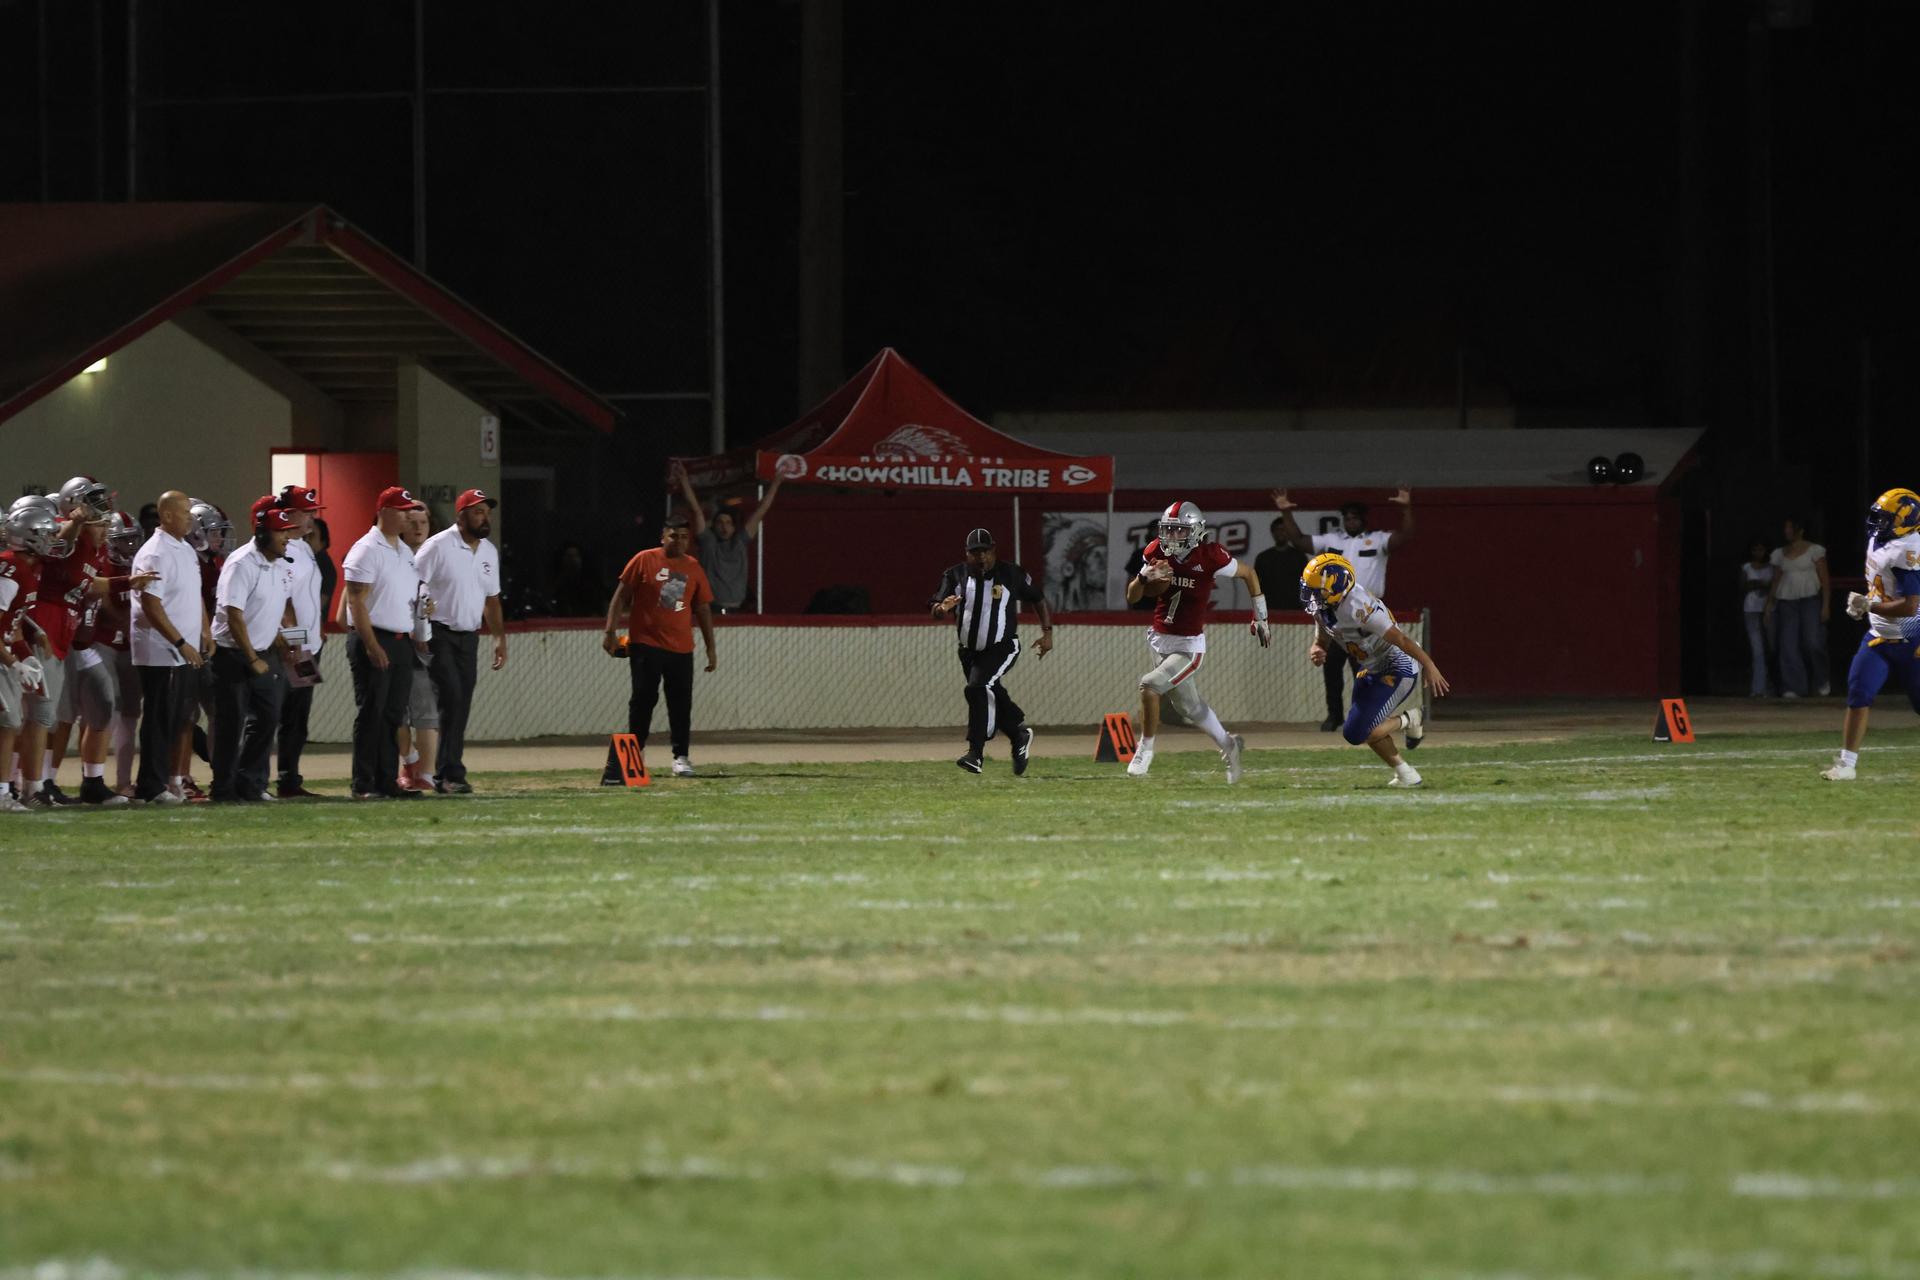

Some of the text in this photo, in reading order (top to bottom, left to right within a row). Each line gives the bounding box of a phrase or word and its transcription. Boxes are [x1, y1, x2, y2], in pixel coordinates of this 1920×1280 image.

[816, 465, 1050, 488] CHOWCHILLA TRIBE
[1170, 576, 1196, 589] RIBE
[1111, 717, 1137, 755] 10
[1671, 702, 1689, 737] G
[619, 738, 645, 778] 20
